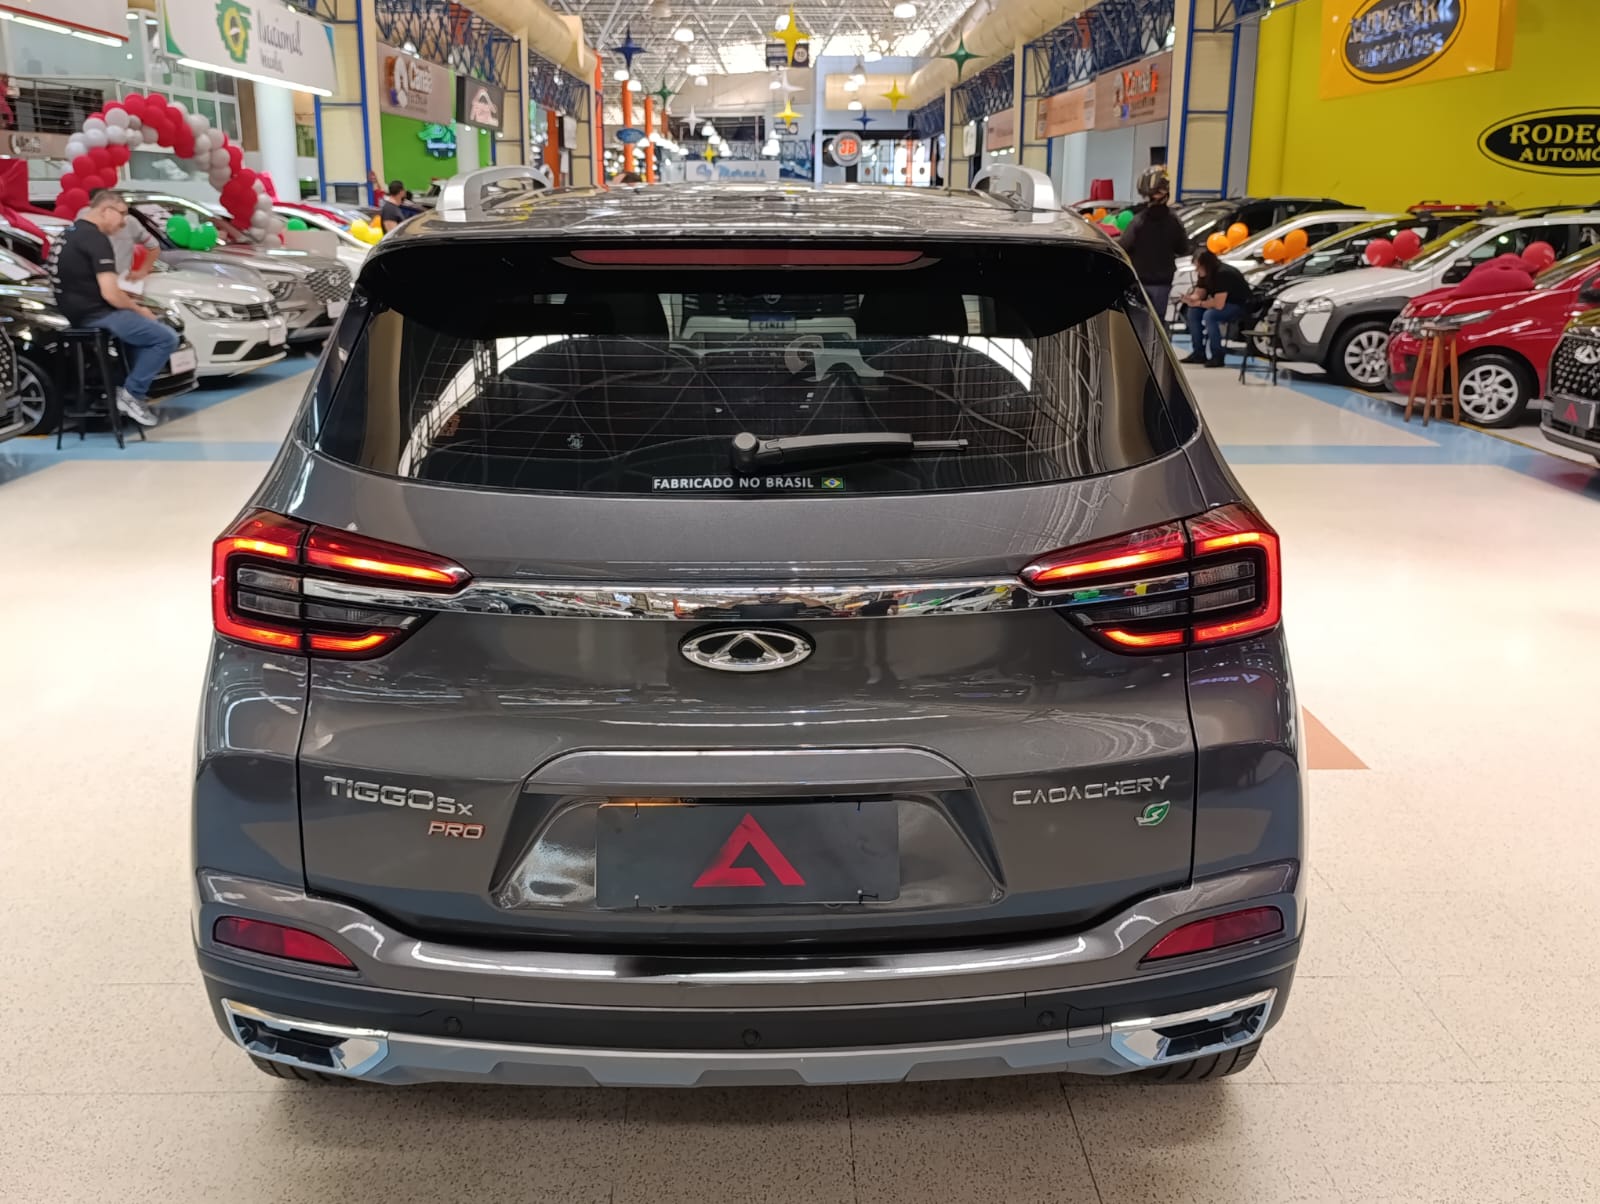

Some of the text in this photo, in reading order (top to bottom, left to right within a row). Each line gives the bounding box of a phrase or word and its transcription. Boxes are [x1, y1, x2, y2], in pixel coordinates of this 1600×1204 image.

[1509, 123, 1600, 145] RODE
[653, 476, 814, 489] FABRICADO NO BRASIL
[1012, 774, 1171, 806] CAOA CHERY
[427, 819, 487, 840] PRO
